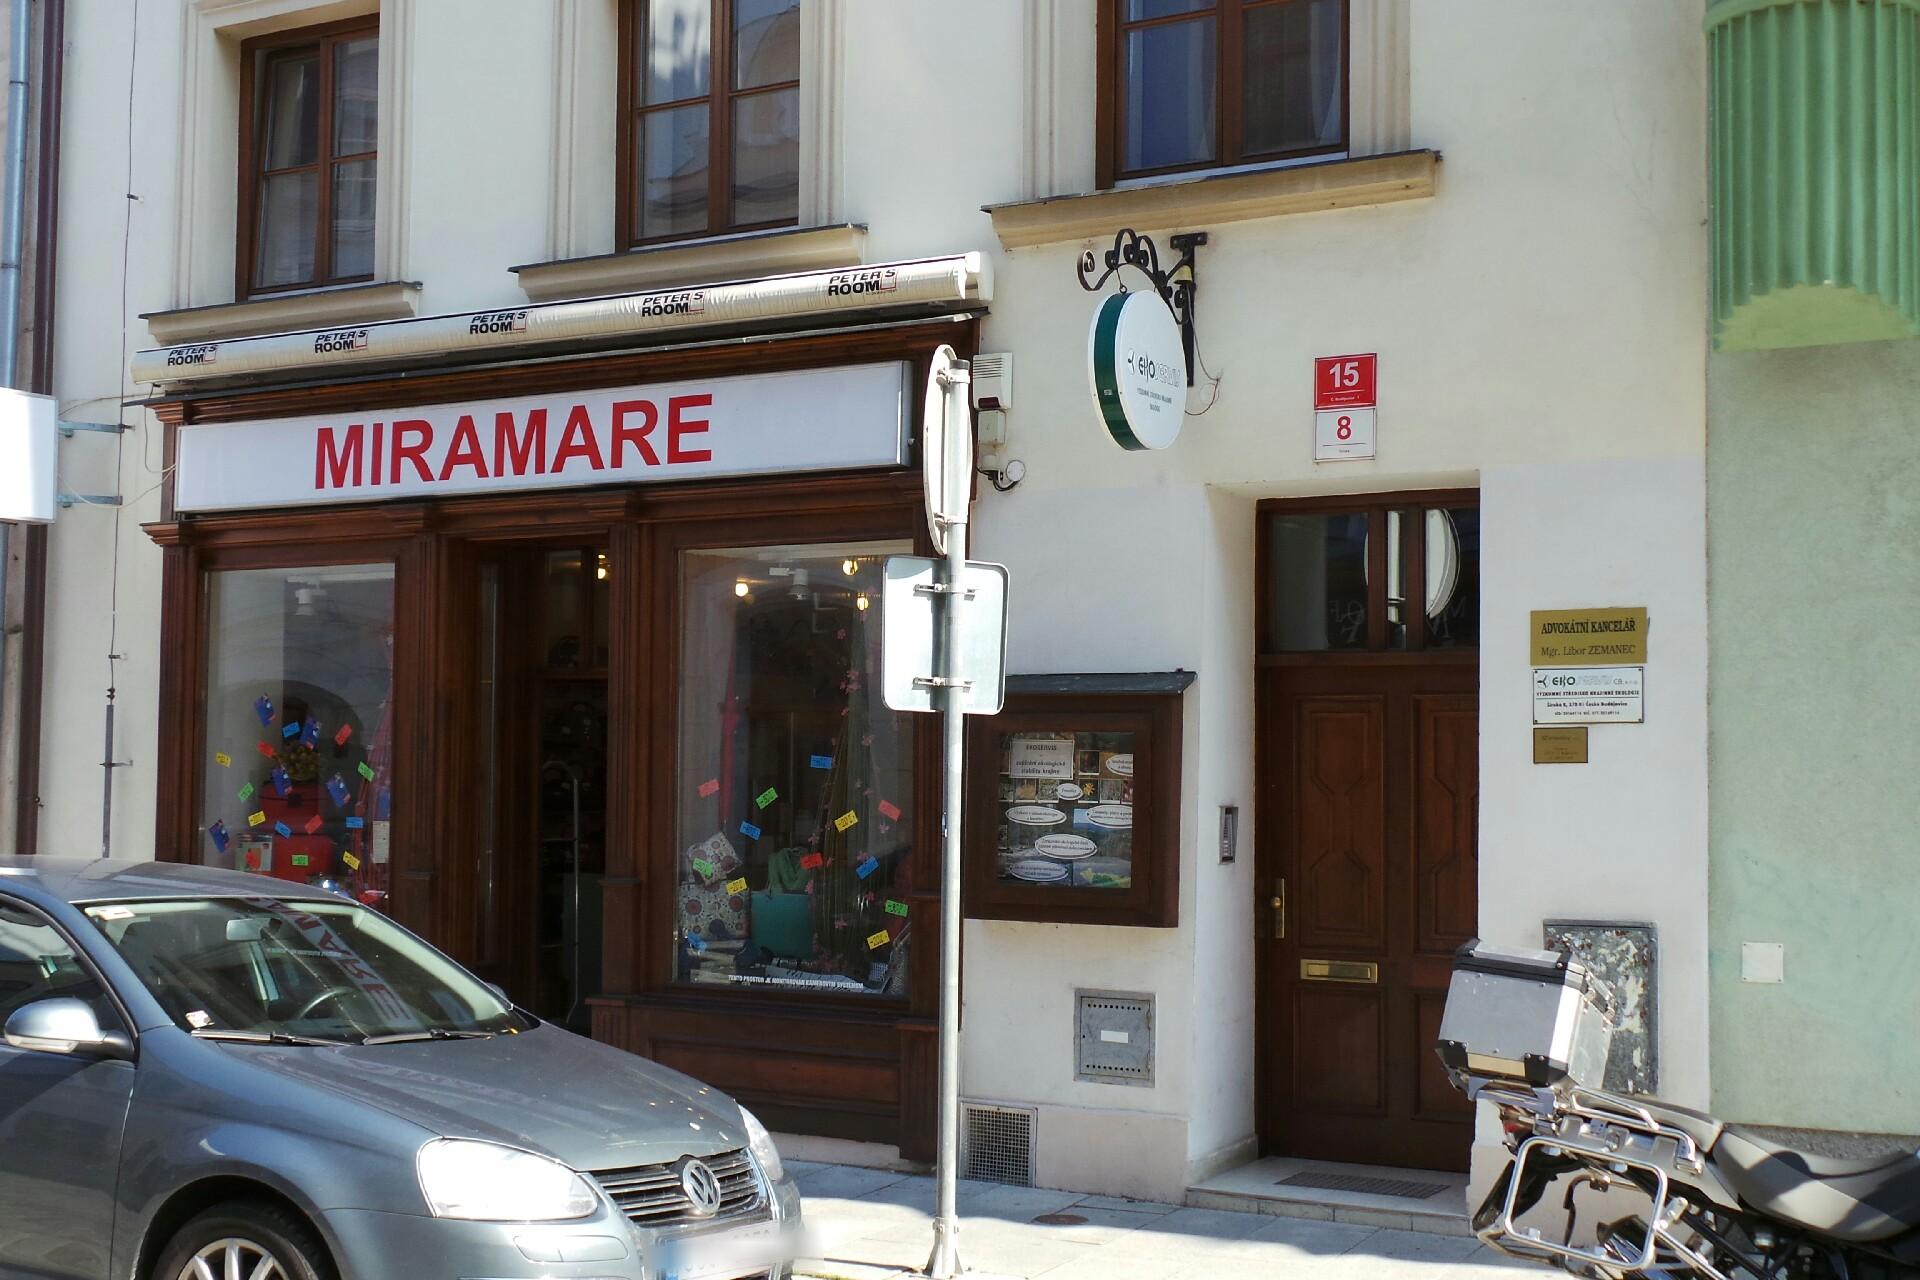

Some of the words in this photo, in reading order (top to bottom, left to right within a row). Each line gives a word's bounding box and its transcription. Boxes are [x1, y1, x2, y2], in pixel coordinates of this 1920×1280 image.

[828, 280, 880, 296] ROOM
[641, 302, 689, 317] ROOM
[469, 321, 512, 335] ROOM
[314, 340, 354, 354] ROOM
[167, 354, 204, 366] ROOM
[1329, 361, 1360, 388] 15
[1336, 415, 1352, 440] 8
[314, 394, 712, 490] MIRAMARE
[1541, 617, 1589, 634] ADVOKÁTNÍ
[1591, 617, 1636, 633] KANCELÁŘ
[1541, 646, 1560, 657] Mgr.
[1563, 645, 1587, 656] Libor
[1588, 644, 1636, 655] ZEMANEC
